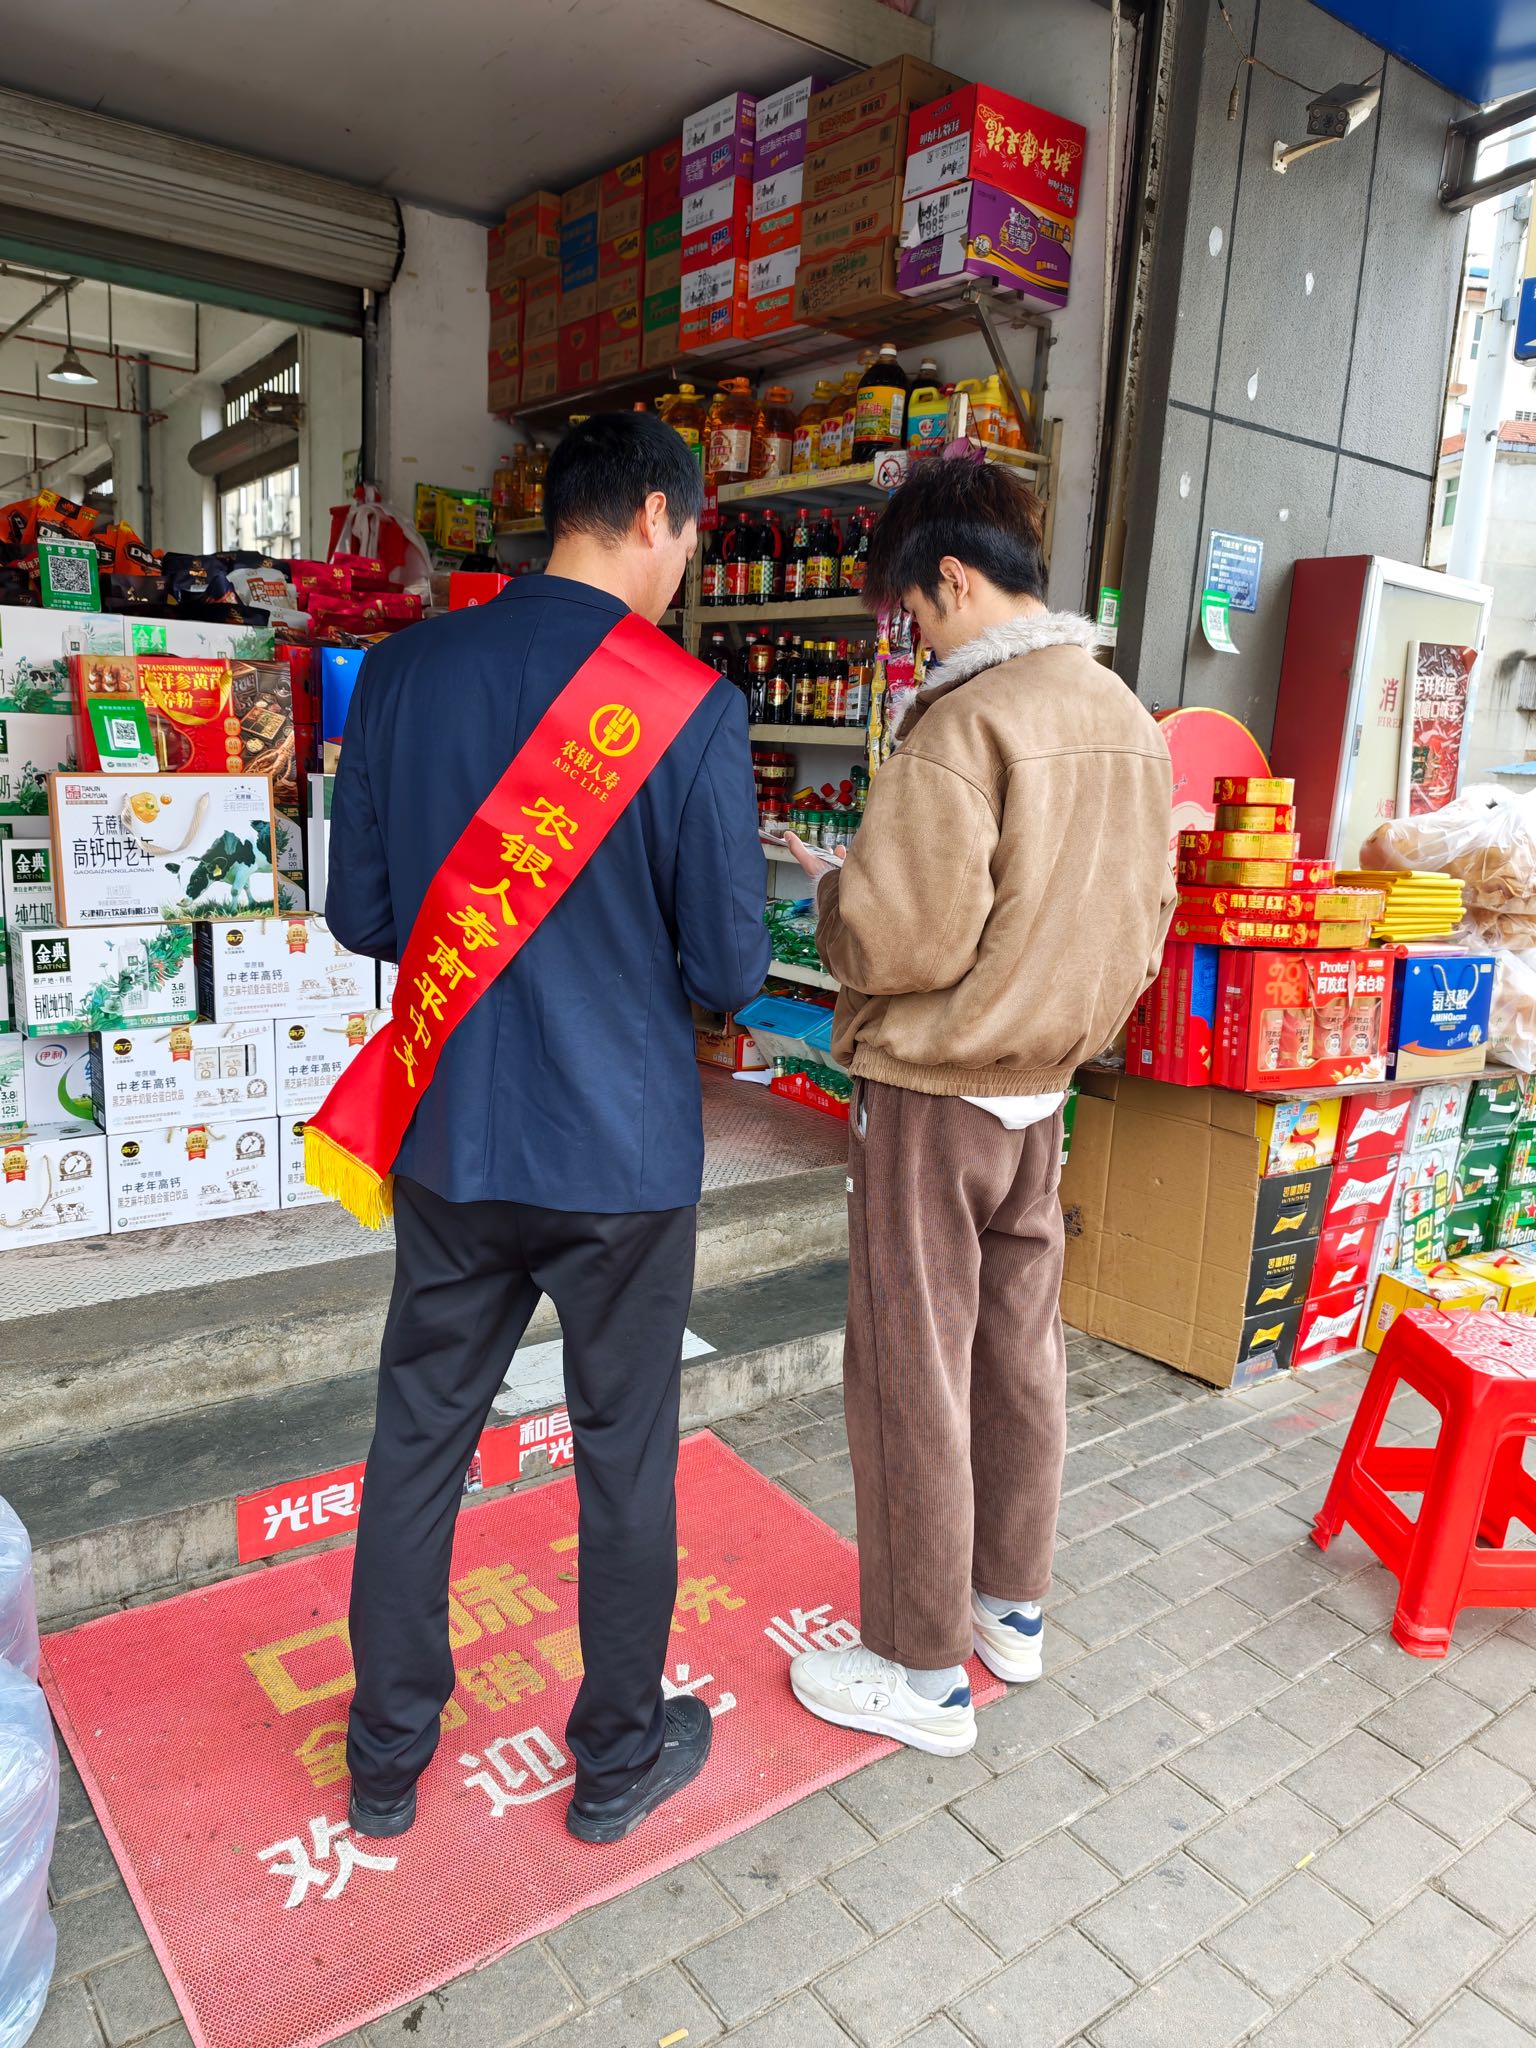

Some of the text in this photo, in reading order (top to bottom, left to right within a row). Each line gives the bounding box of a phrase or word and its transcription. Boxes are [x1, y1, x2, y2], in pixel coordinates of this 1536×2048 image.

[711, 144, 729, 164] BIG
[711, 226, 729, 245] BIG
[710, 306, 729, 324] BIG
[1378, 677, 1400, 714] 消
[560, 740, 621, 791] 农银人寿
[552, 756, 610, 803] ABC LIFE
[72, 837, 155, 869] 高钙中老年
[15, 852, 47, 874] 金典
[14, 902, 55, 926] 纯牛奶
[35, 941, 68, 965] 金典
[36, 963, 69, 971] SATINE
[226, 969, 283, 983] 中老年高钙
[1319, 960, 1350, 974] Protei
[171, 982, 185, 992] 3.8
[1317, 974, 1386, 994] 阿胶红蛋白粉
[38, 1050, 63, 1061] 伊利
[288, 1061, 342, 1077] 中老年高钙
[116, 1076, 177, 1093] 中老年高钙
[1, 1091, 16, 1101] 3.8
[121, 1177, 182, 1195] 中老年高钙
[1341, 1183, 1388, 1202] Budweiser
[1311, 1317, 1356, 1338] Budweiser
[263, 1484, 356, 1542] 光良
[256, 1602, 862, 1909] 欢迎光临
